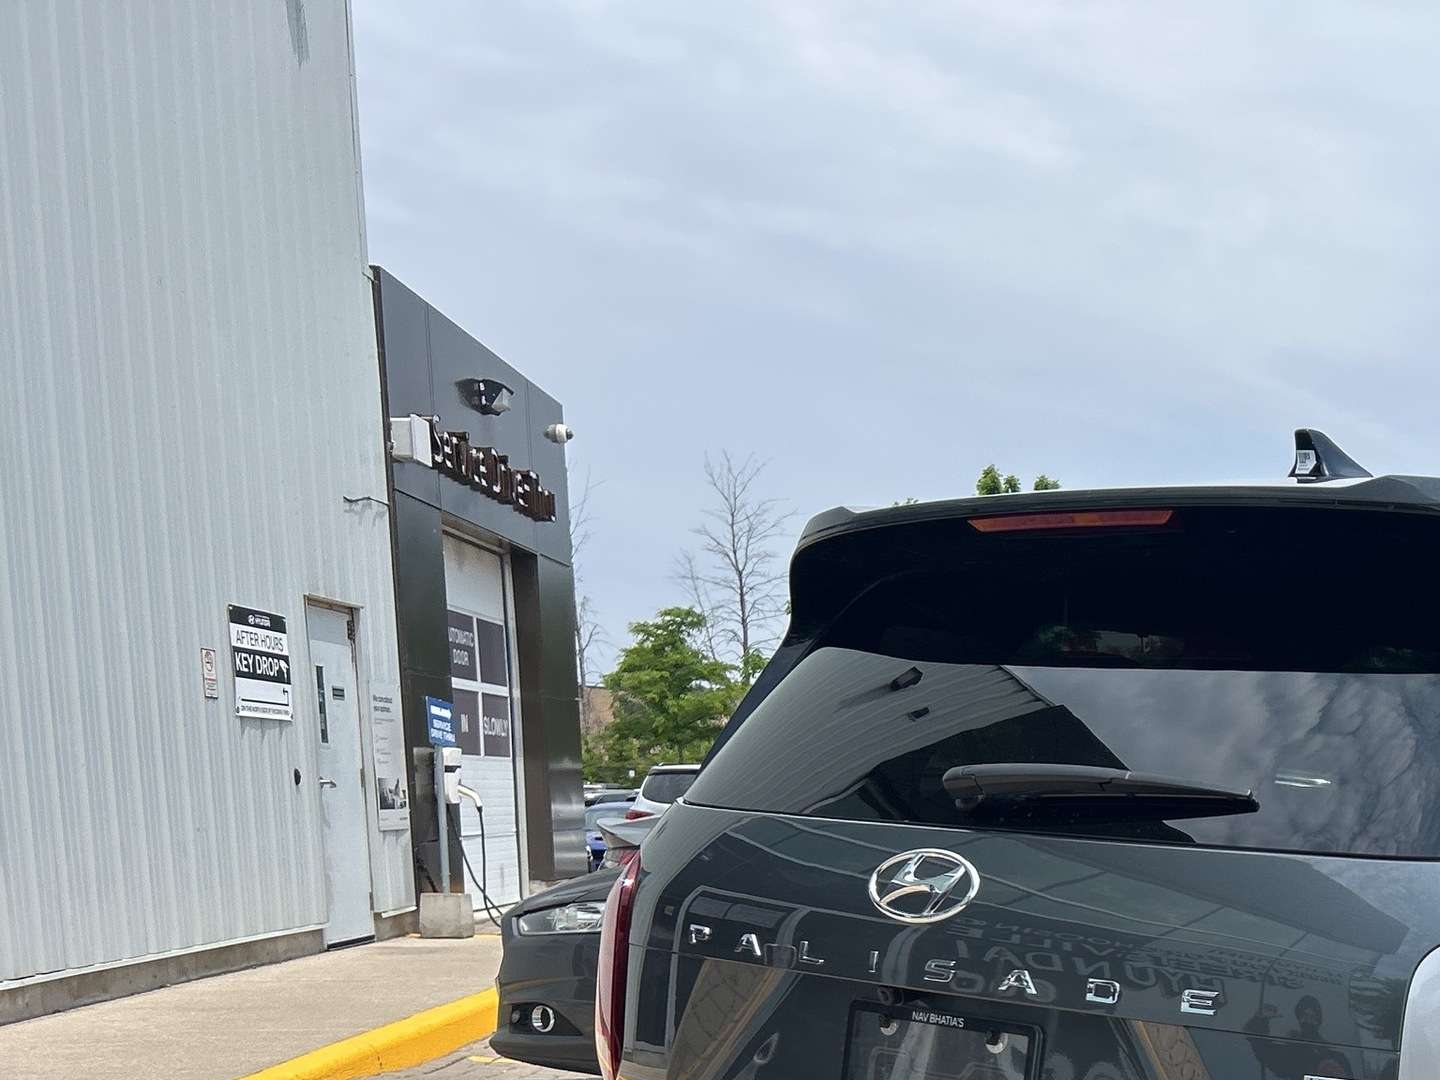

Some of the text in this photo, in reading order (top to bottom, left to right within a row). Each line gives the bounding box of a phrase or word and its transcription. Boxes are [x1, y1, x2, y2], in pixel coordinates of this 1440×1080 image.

[236, 629, 284, 652] AFTER HOURS
[448, 627, 475, 647] UTOMATIC
[235, 652, 280, 677] KEY DROP
[453, 649, 470, 666] DOOR
[483, 716, 508, 736] SLOWLY
[688, 923, 1218, 1016] PALISADE
[912, 1011, 964, 1028] NAV BHATIA'S
